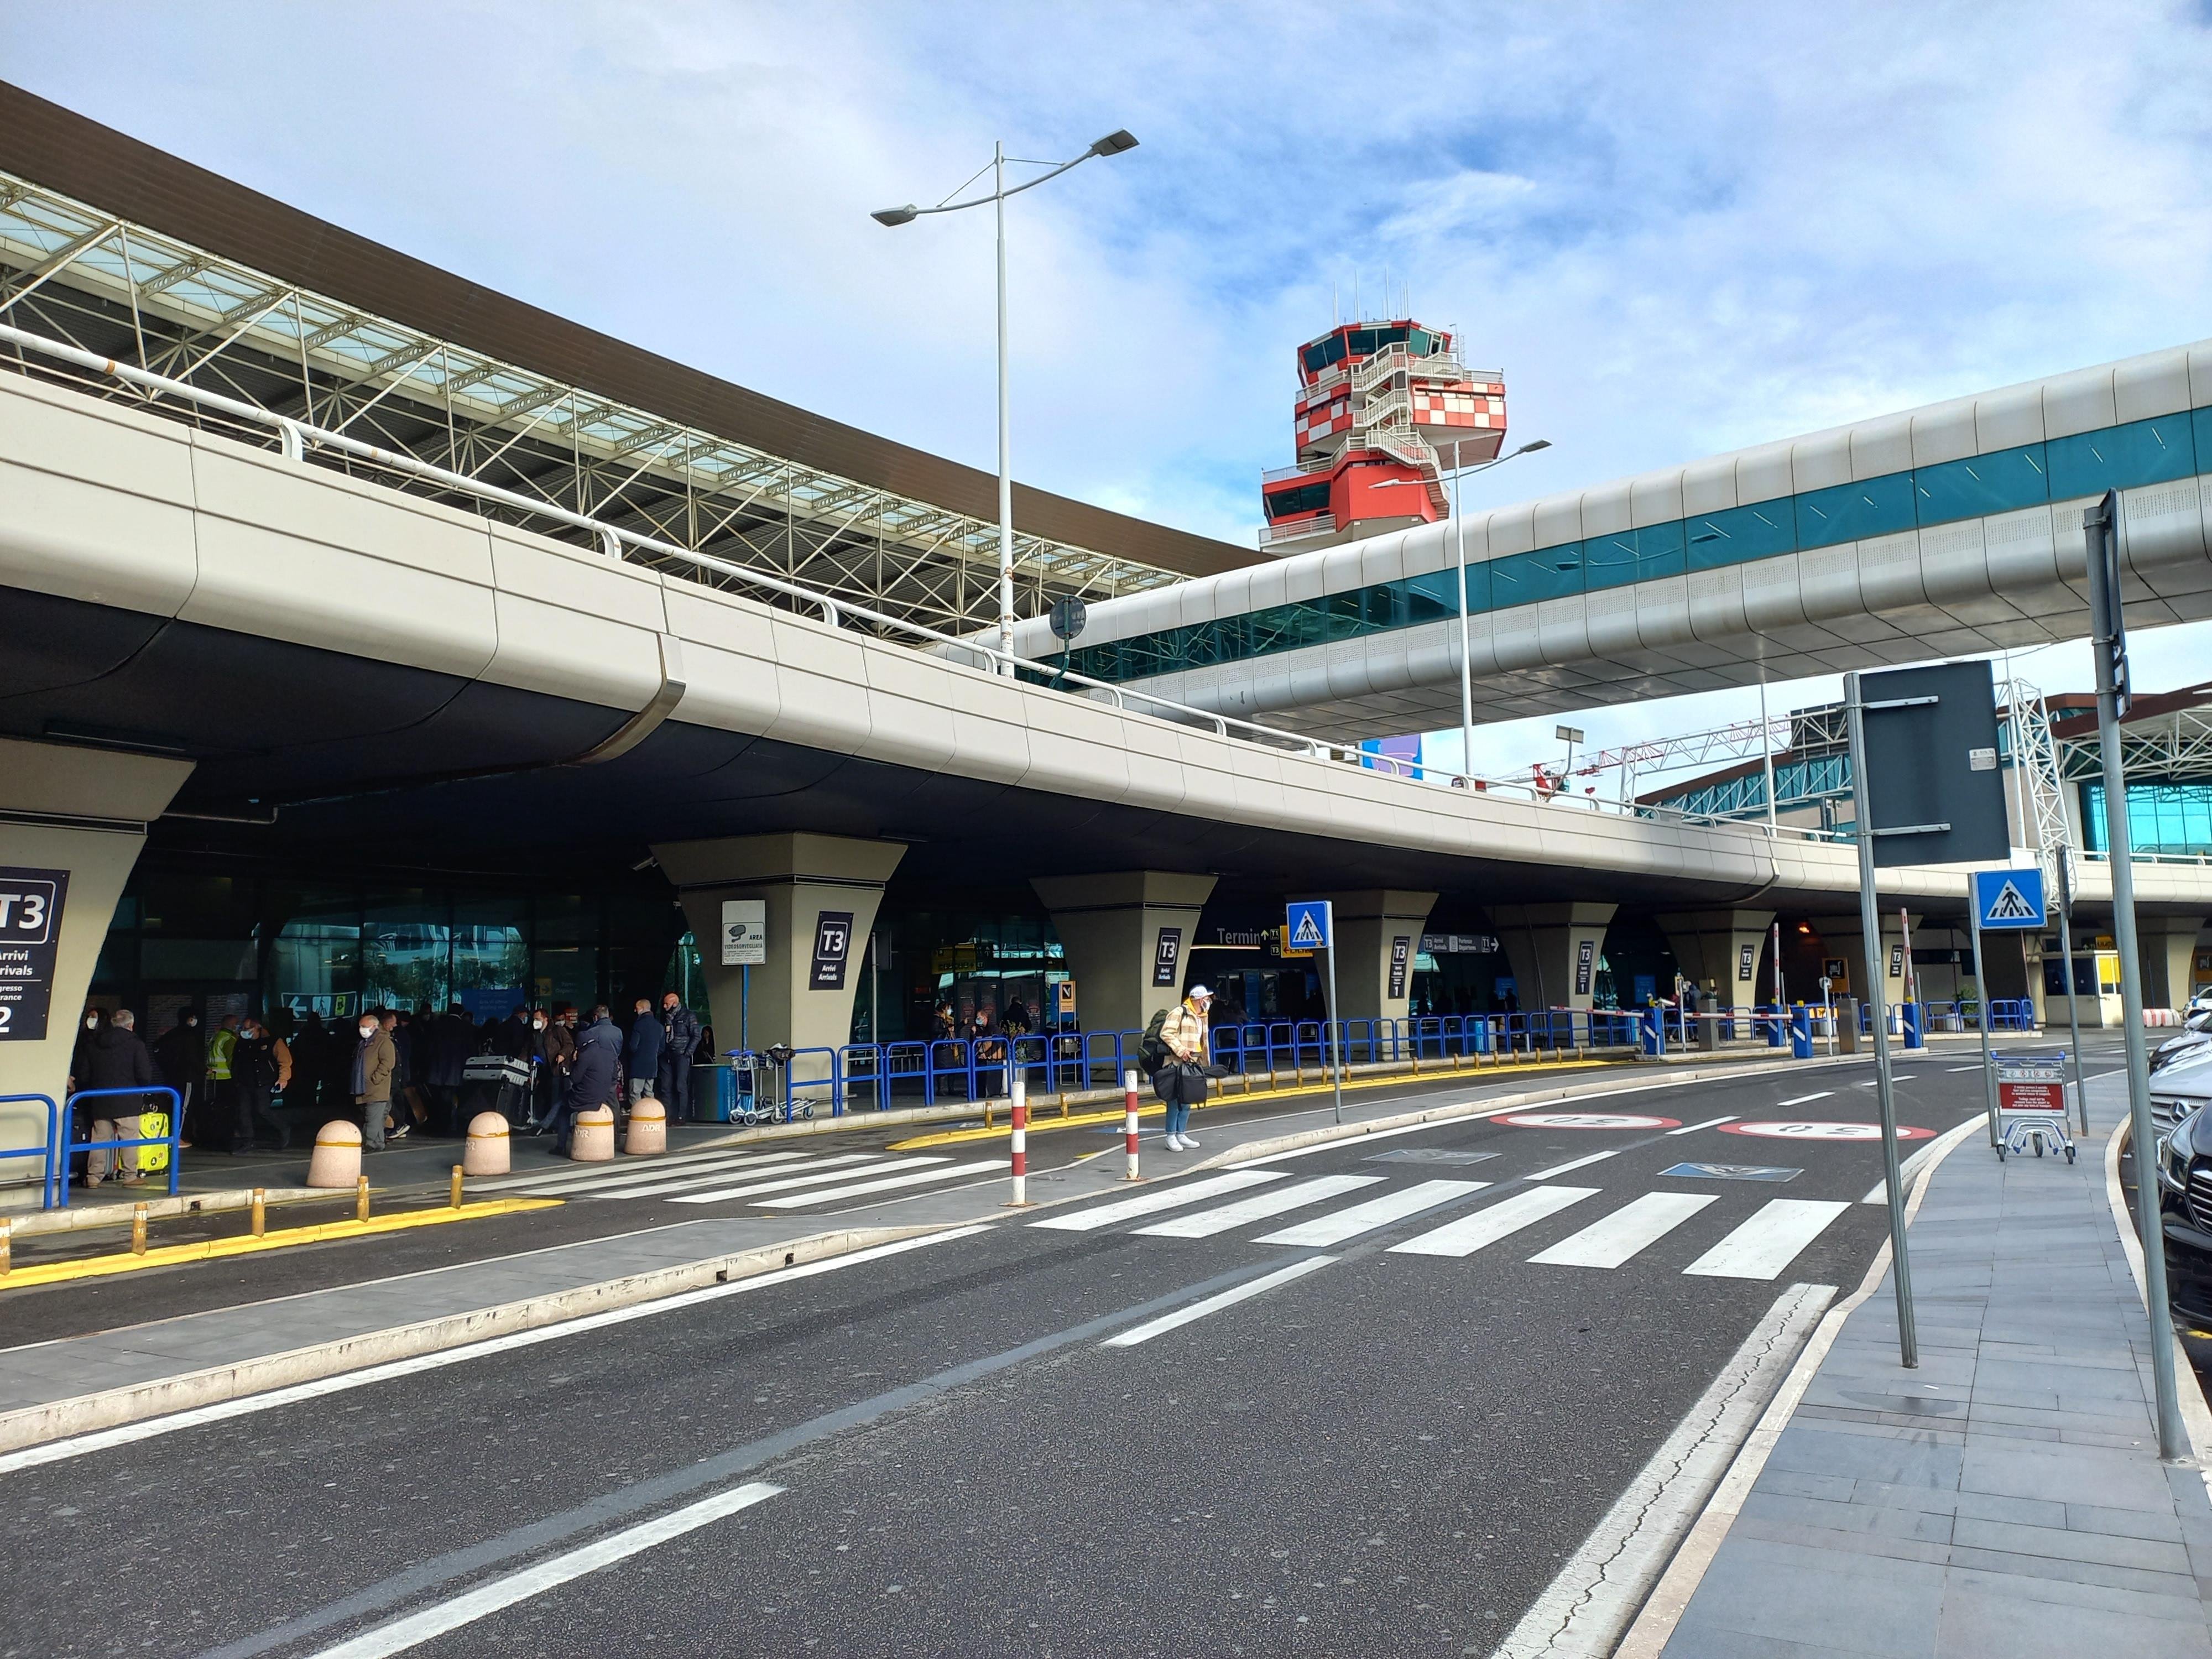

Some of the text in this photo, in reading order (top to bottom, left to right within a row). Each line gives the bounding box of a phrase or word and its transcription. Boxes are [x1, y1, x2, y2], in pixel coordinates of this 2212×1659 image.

[0, 894, 45, 929] T3
[823, 930, 844, 952] T3
[1217, 928, 1260, 945] Termin
[1162, 942, 1176, 958] T3
[1396, 946, 1406, 959] T3
[1582, 949, 1590, 961] T3
[1743, 953, 1751, 963] T3
[1893, 952, 1901, 962] T3
[0, 964, 33, 975] rivals
[1395, 986, 1399, 997] 1
[0, 1006, 12, 1033] 2
[641, 1124, 662, 1133] ADR
